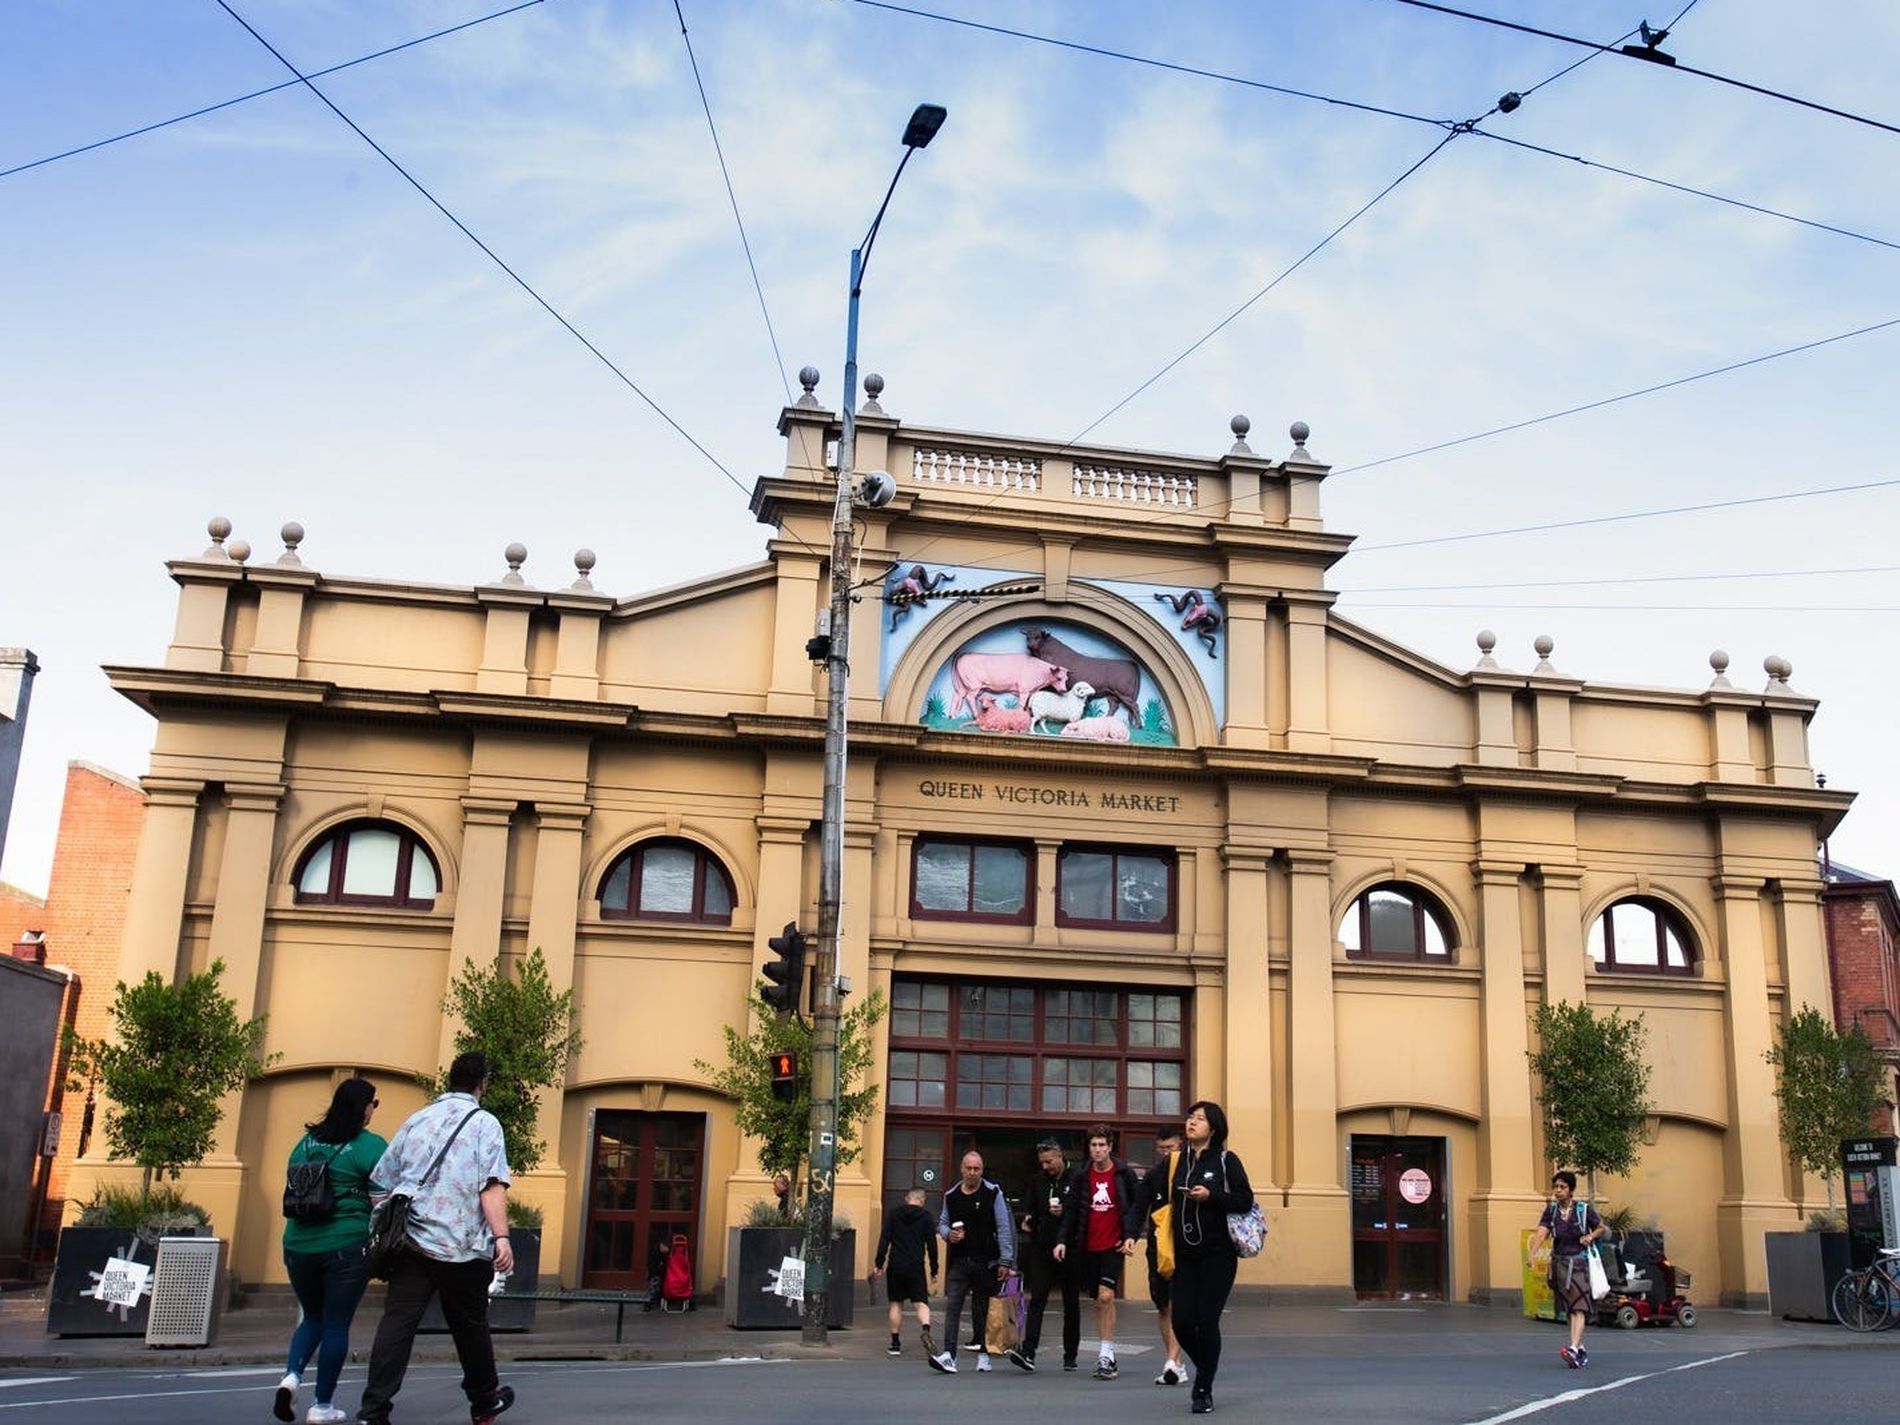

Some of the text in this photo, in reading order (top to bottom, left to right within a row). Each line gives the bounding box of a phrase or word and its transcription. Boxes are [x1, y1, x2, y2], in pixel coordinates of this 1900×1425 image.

[919, 780, 1179, 812] QUEEN VICTORIA MARKET
[105, 1270, 128, 1282] QUEEN
[103, 1280, 136, 1291] VICTORIA
[102, 1290, 131, 1301] MARKET
